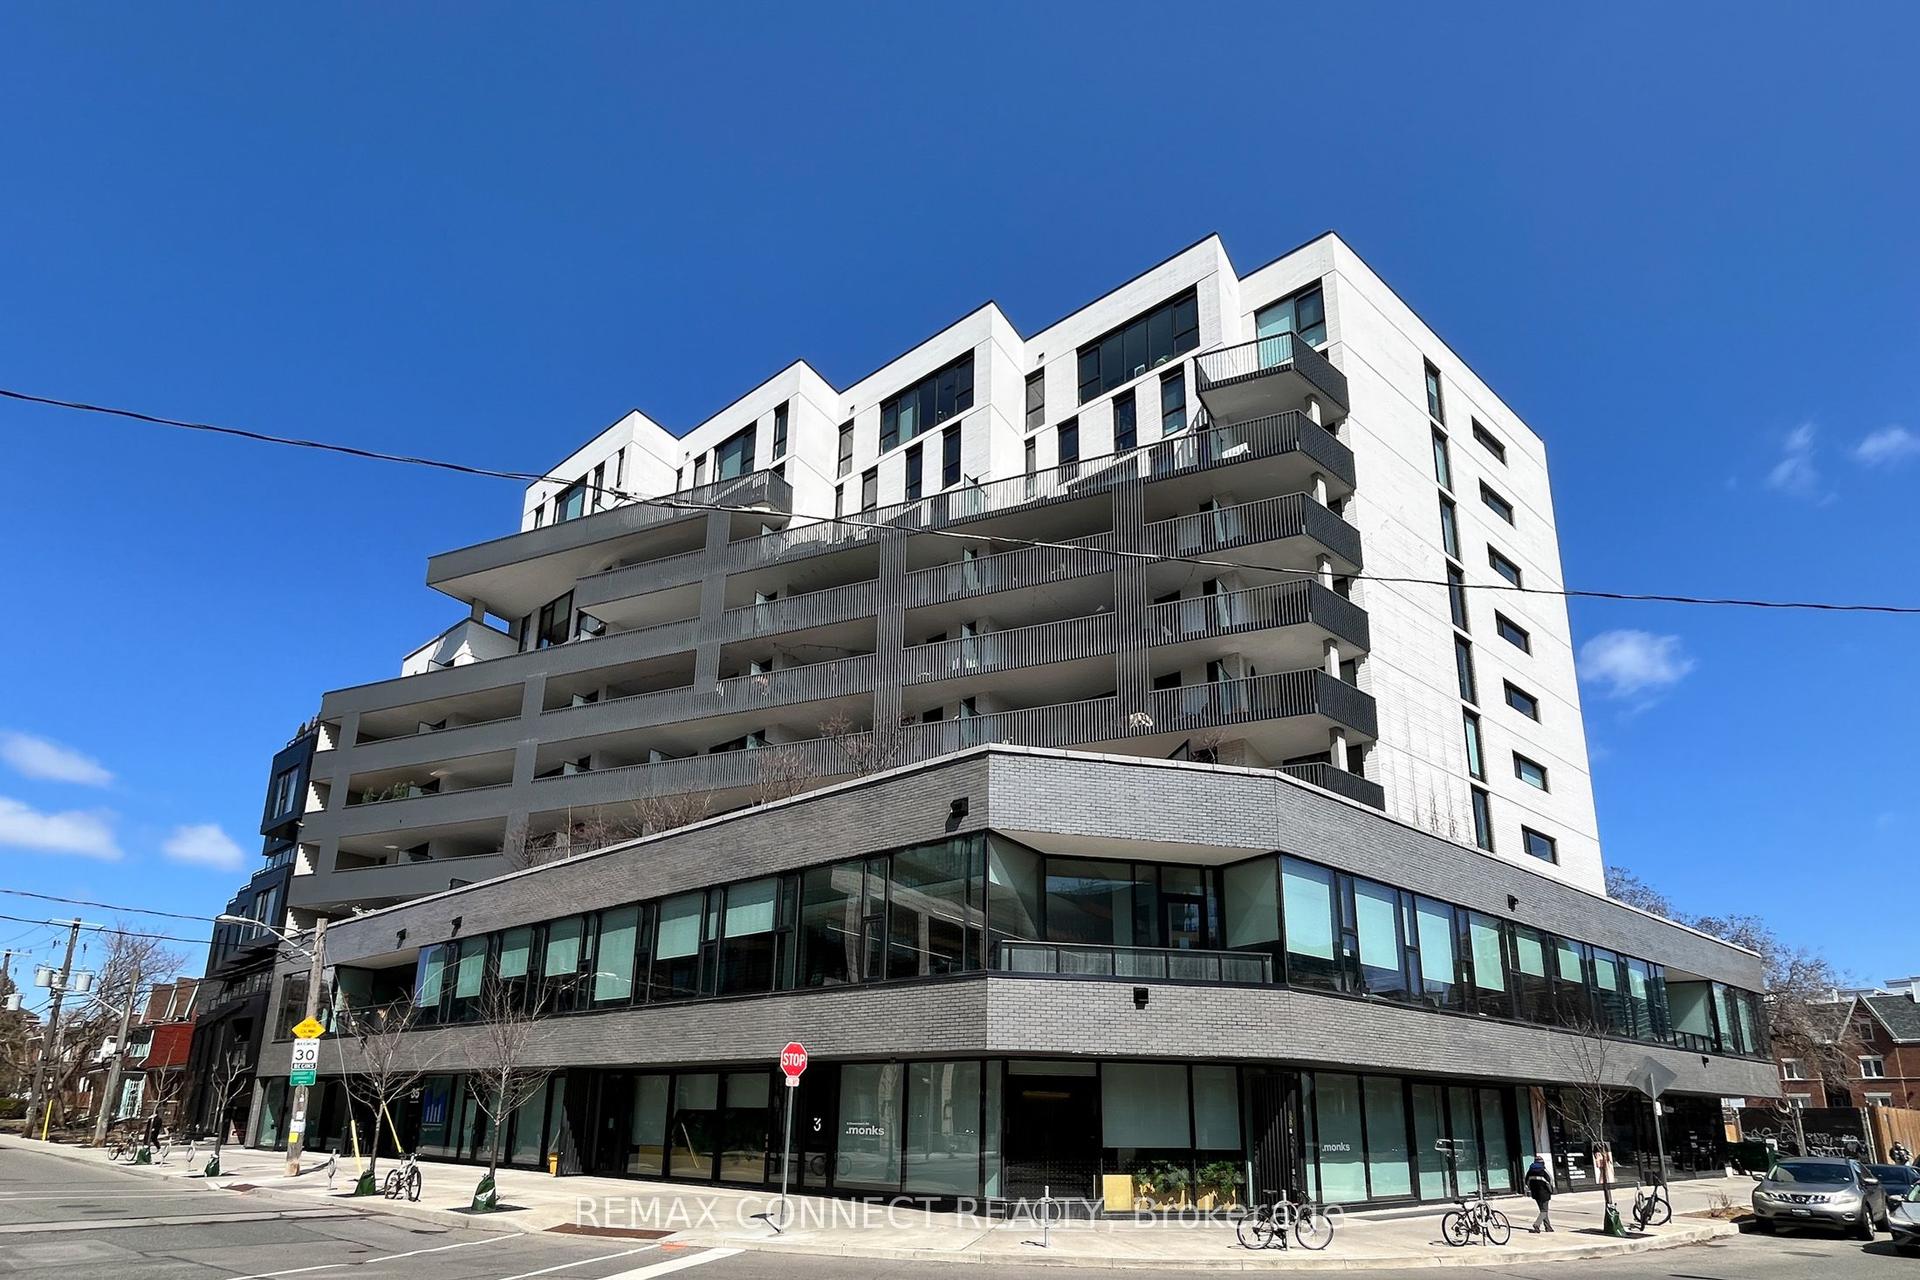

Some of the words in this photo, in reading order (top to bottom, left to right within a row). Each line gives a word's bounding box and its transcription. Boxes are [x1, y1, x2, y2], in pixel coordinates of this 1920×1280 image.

[295, 1050, 314, 1060] 30
[783, 1053, 806, 1066] STOP
[845, 1125, 885, 1136] .monks
